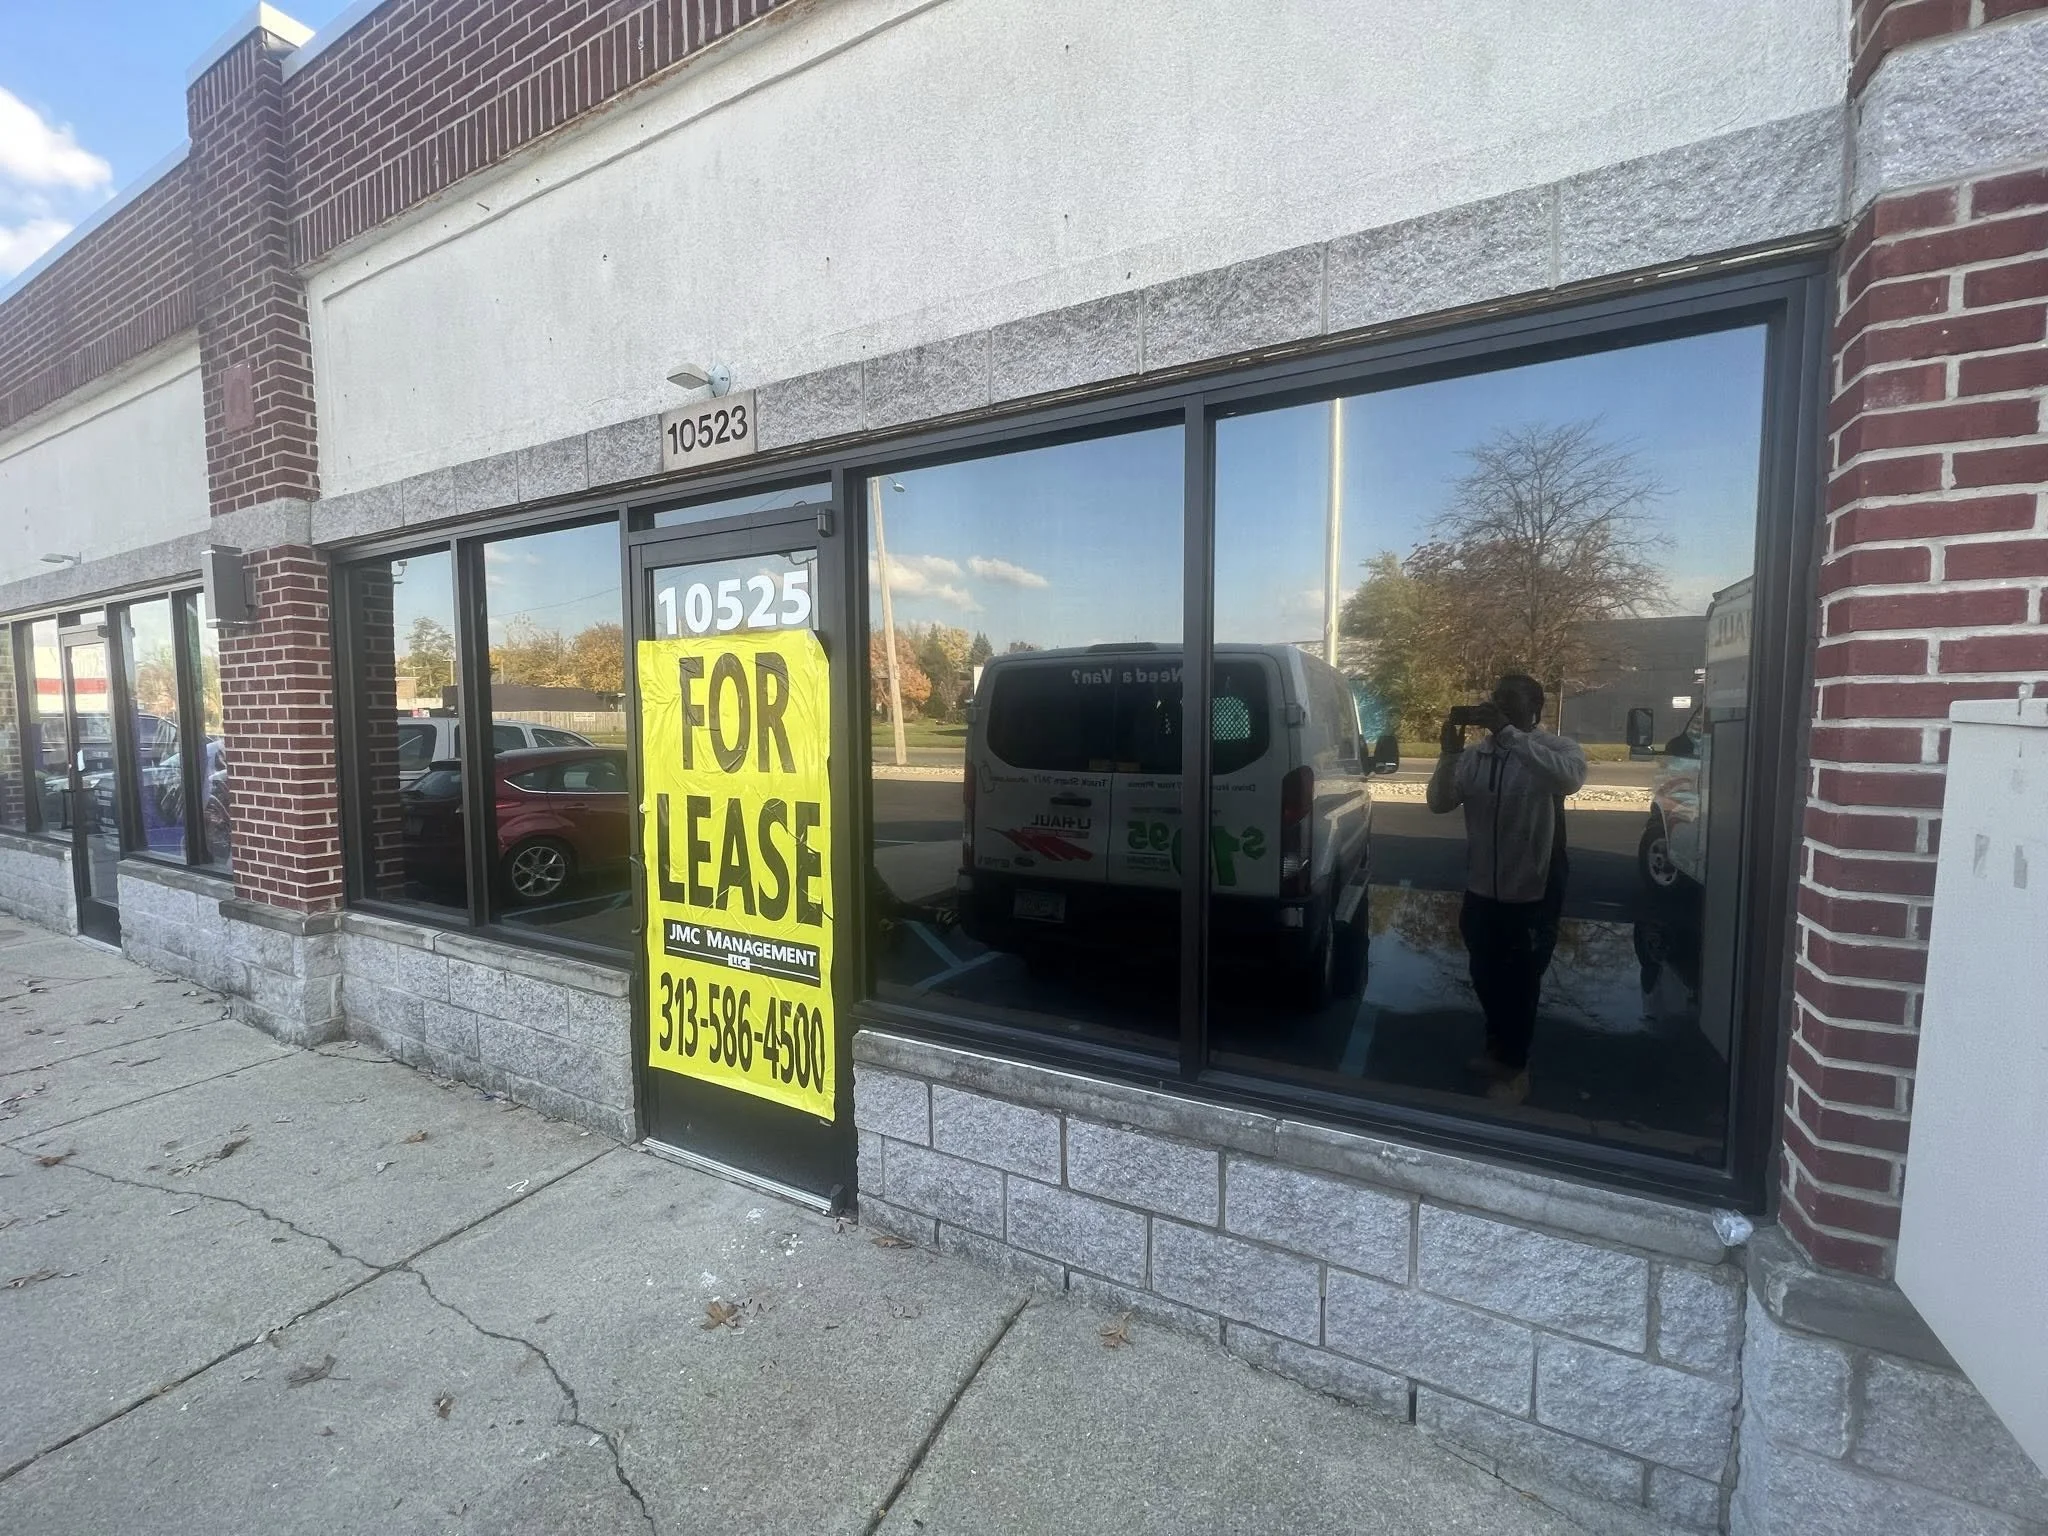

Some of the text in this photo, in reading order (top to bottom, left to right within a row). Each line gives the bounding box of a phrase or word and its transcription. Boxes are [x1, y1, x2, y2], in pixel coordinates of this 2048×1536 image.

[667, 405, 748, 455] 10523
[658, 570, 812, 635] 10525
[678, 652, 796, 774] FOR
[657, 794, 824, 928] LEASE
[669, 923, 817, 967] JMC MANAGEMENT
[731, 955, 748, 968] LLC
[660, 972, 825, 1094] 313-586-4500
